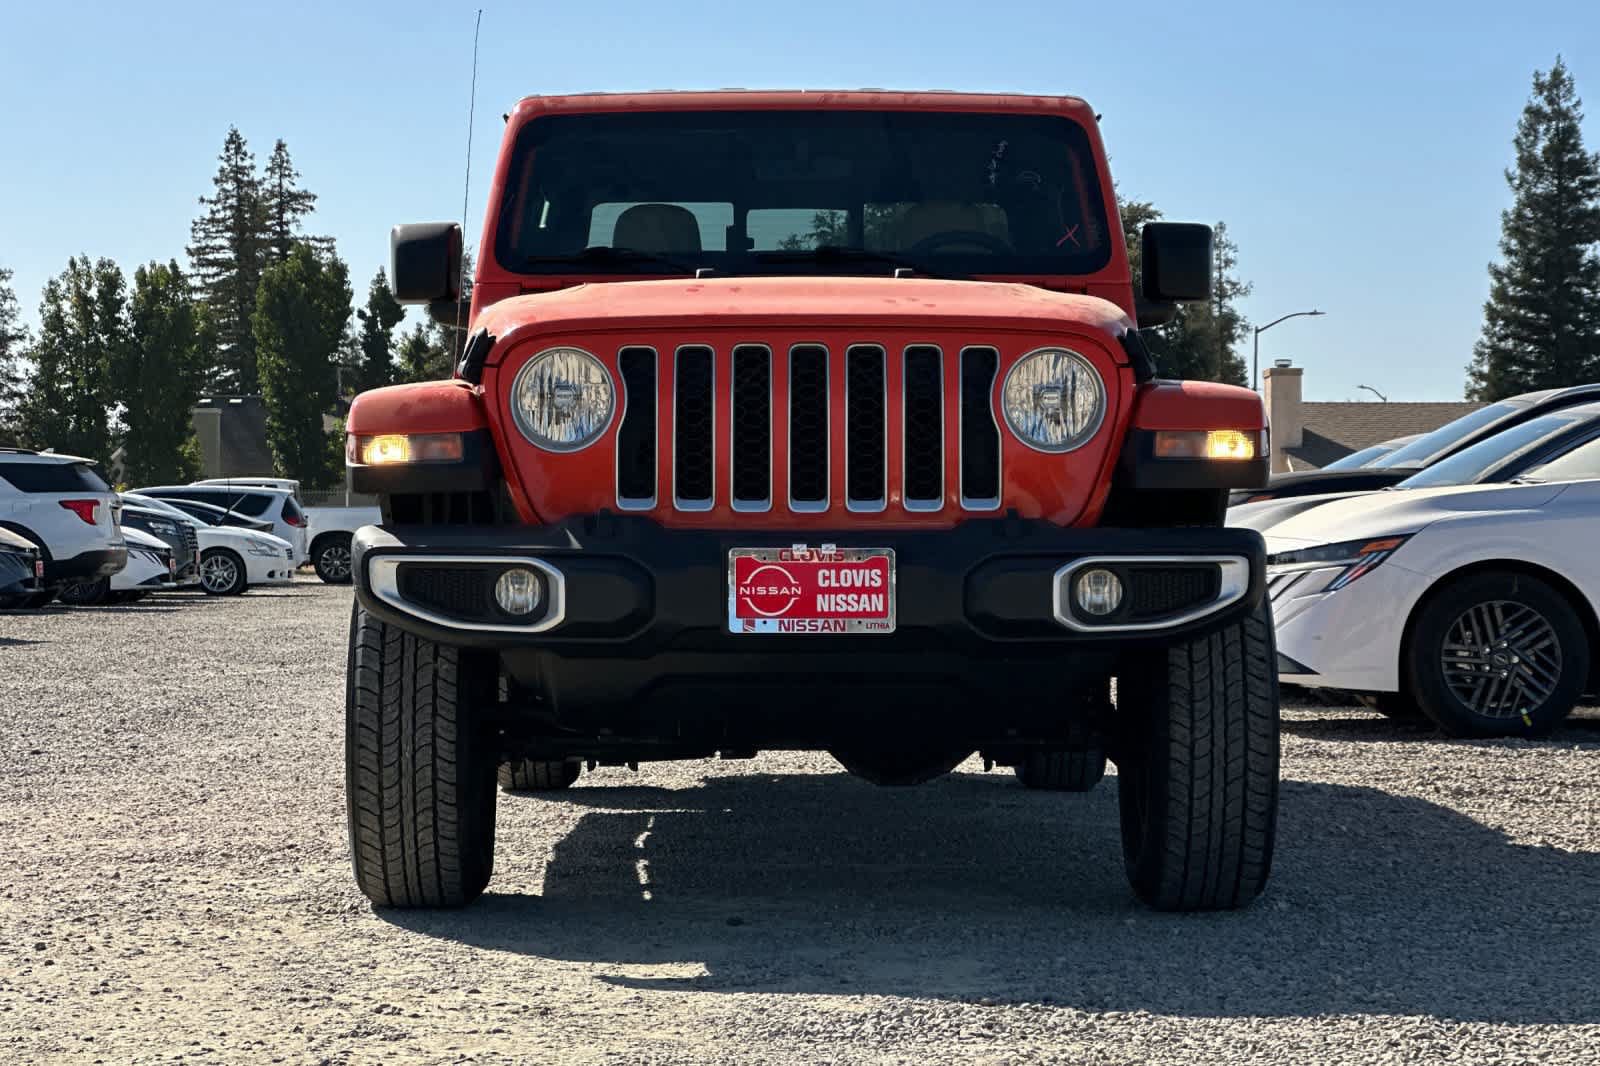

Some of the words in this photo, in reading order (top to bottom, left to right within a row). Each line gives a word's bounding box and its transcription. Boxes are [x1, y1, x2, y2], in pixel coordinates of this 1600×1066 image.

[779, 549, 845, 562] CLOVIS
[817, 568, 882, 588] CLOVIS
[739, 586, 802, 595] NISSAN
[816, 593, 884, 613] NISSAN
[778, 619, 847, 632] NISSAN
